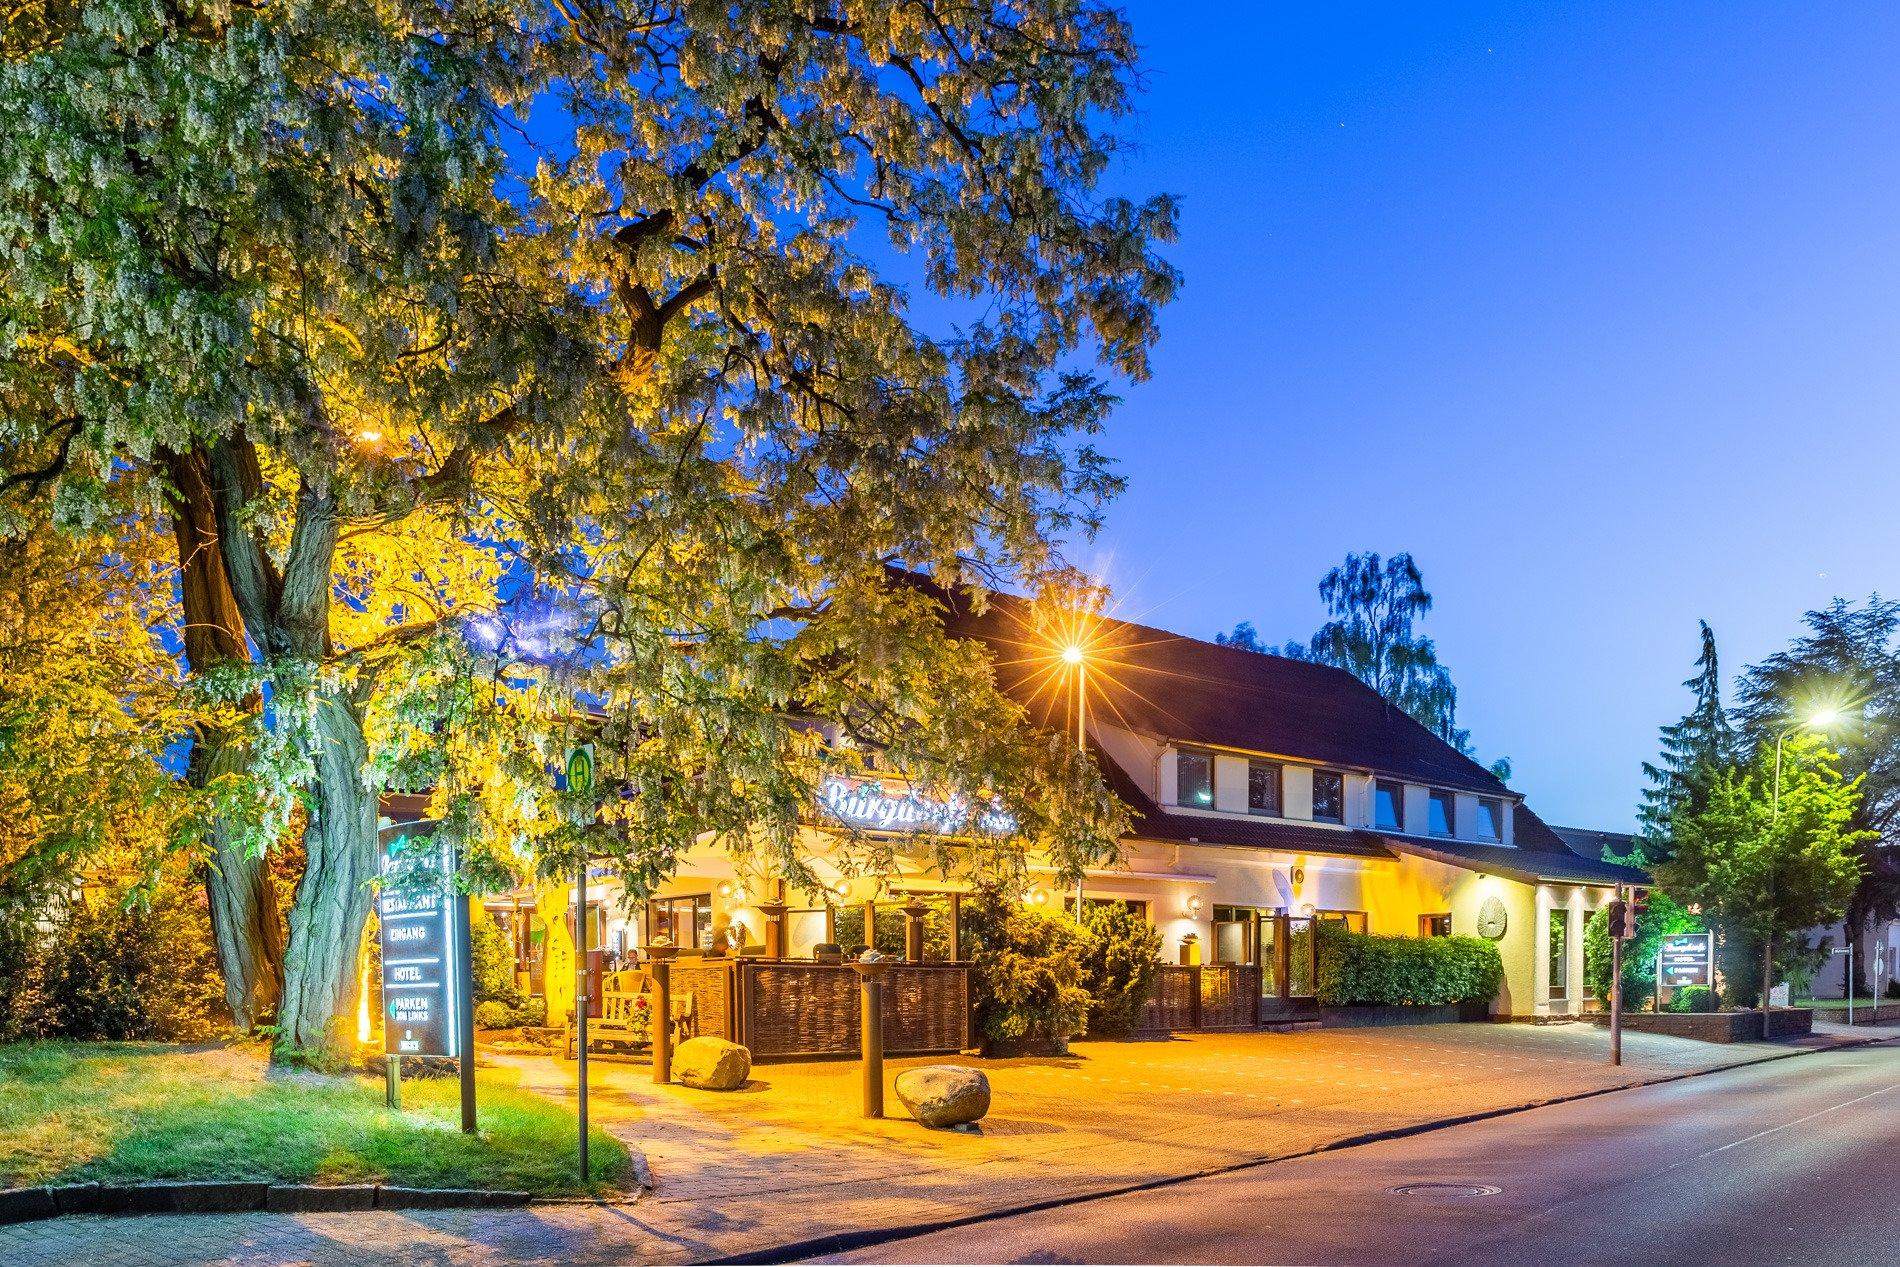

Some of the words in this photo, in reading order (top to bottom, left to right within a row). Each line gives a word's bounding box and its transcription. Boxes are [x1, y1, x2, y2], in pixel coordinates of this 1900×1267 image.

[390, 926, 426, 941] EINGANG
[394, 966, 422, 982] HOTEL
[395, 997, 428, 1010] PARKEN
